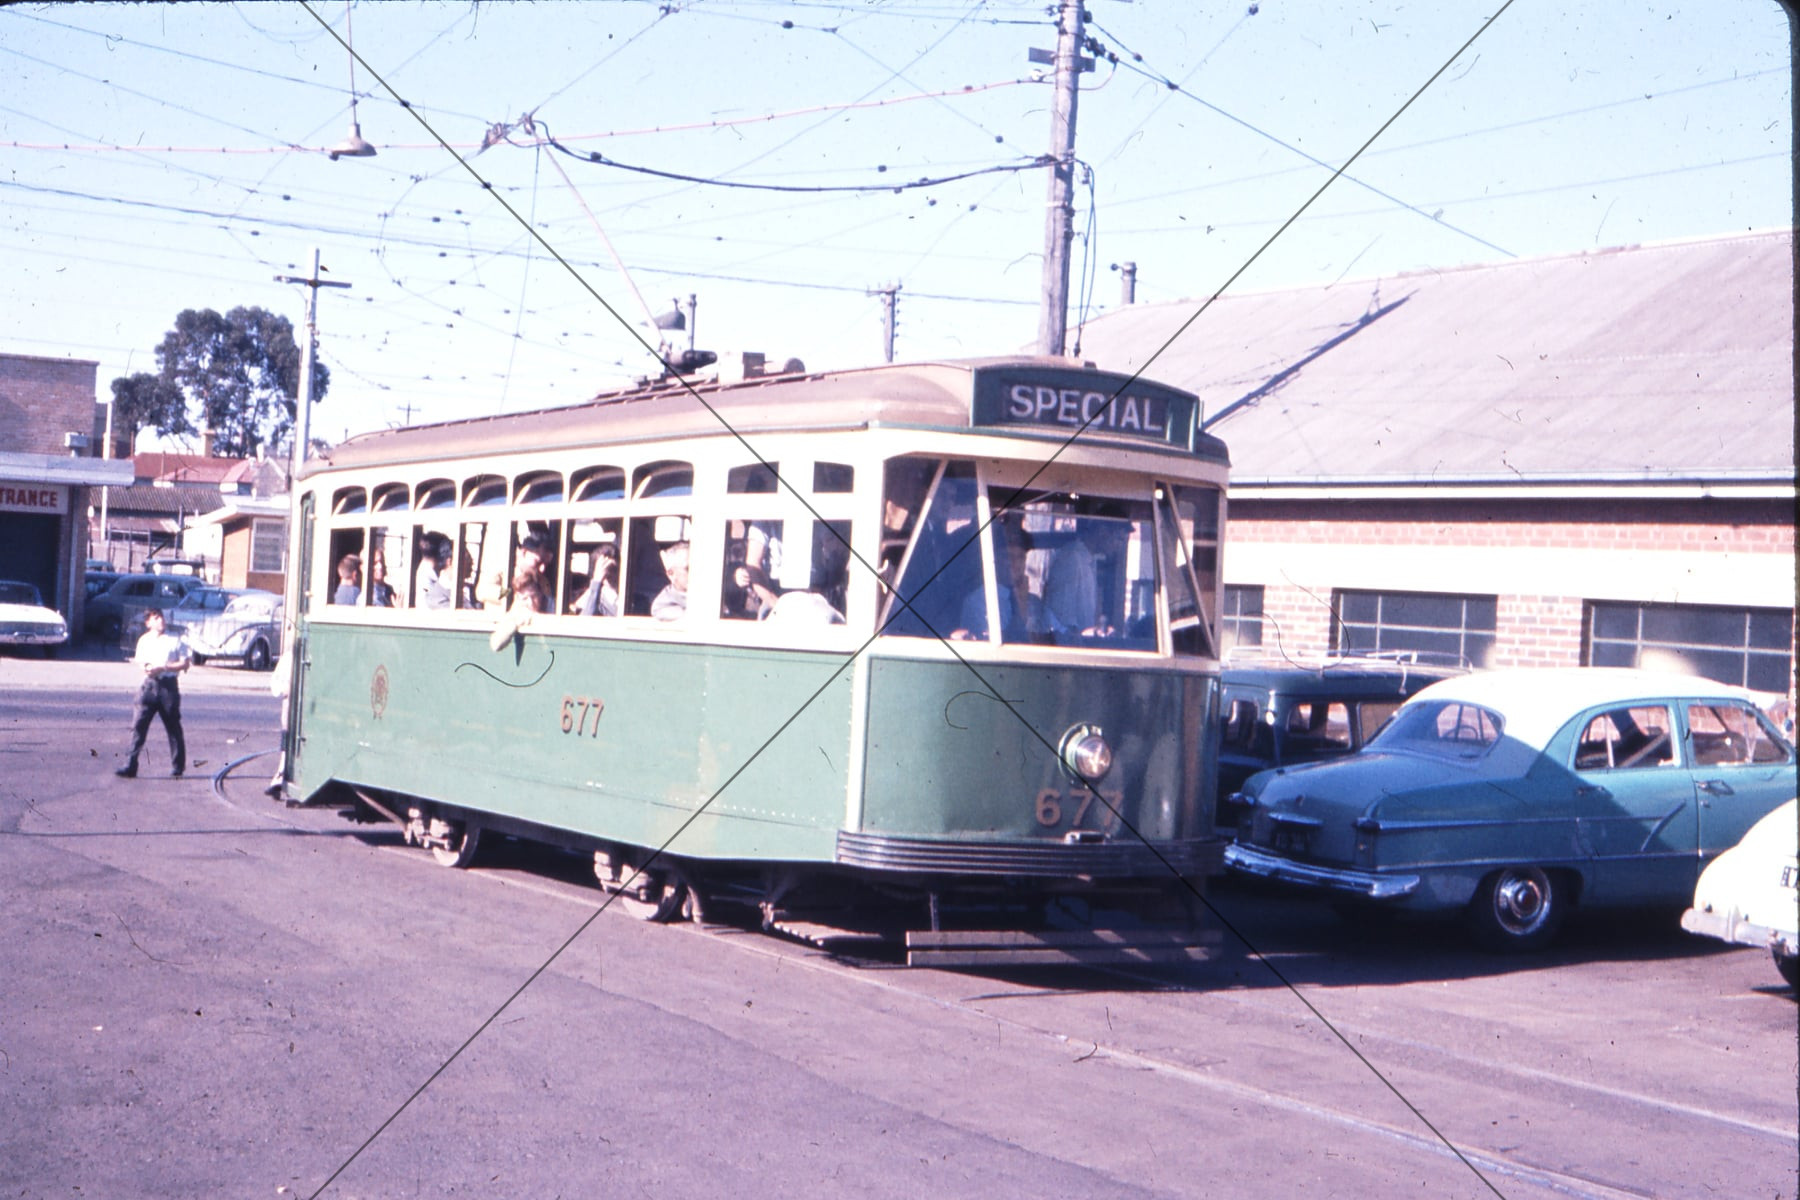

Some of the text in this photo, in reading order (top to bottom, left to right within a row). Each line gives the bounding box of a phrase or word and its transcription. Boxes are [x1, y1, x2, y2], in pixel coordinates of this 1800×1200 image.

[1010, 384, 1162, 431] SPECIAL
[561, 695, 604, 738] 677
[1035, 787, 1124, 827] 677
